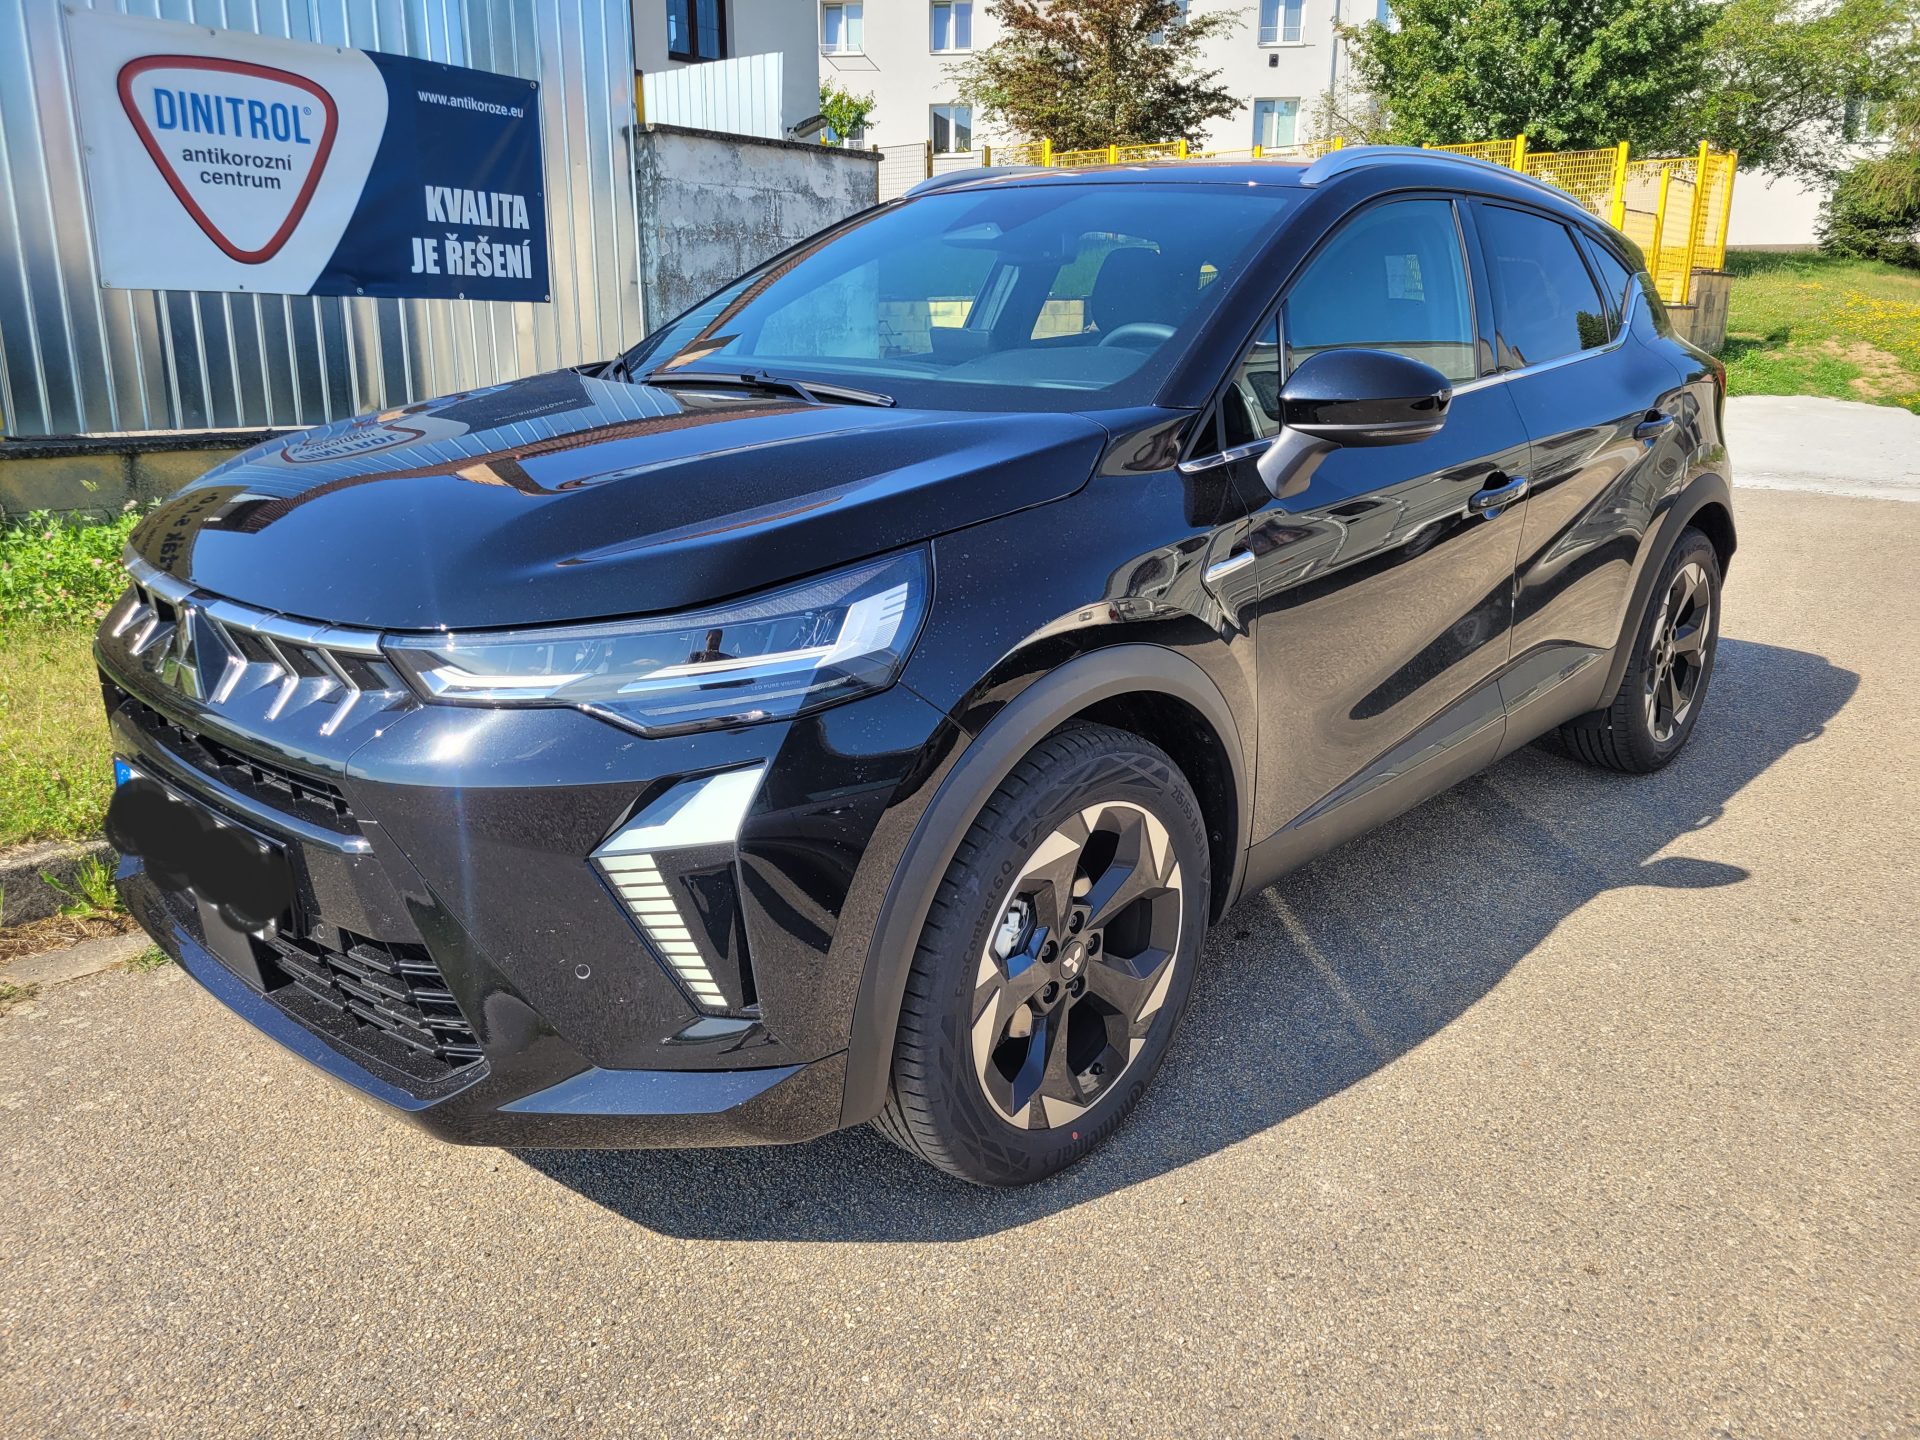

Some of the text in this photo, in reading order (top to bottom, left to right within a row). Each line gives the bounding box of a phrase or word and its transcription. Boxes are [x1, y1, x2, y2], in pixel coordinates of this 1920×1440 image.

[417, 90, 524, 118] www.antikoroze.eu
[182, 148, 293, 171] antikorozní
[200, 170, 282, 190] centrum
[424, 185, 530, 230] KVALITA
[411, 233, 533, 279] JE ŘEŠENÍ
[955, 891, 998, 998] EcoContact
